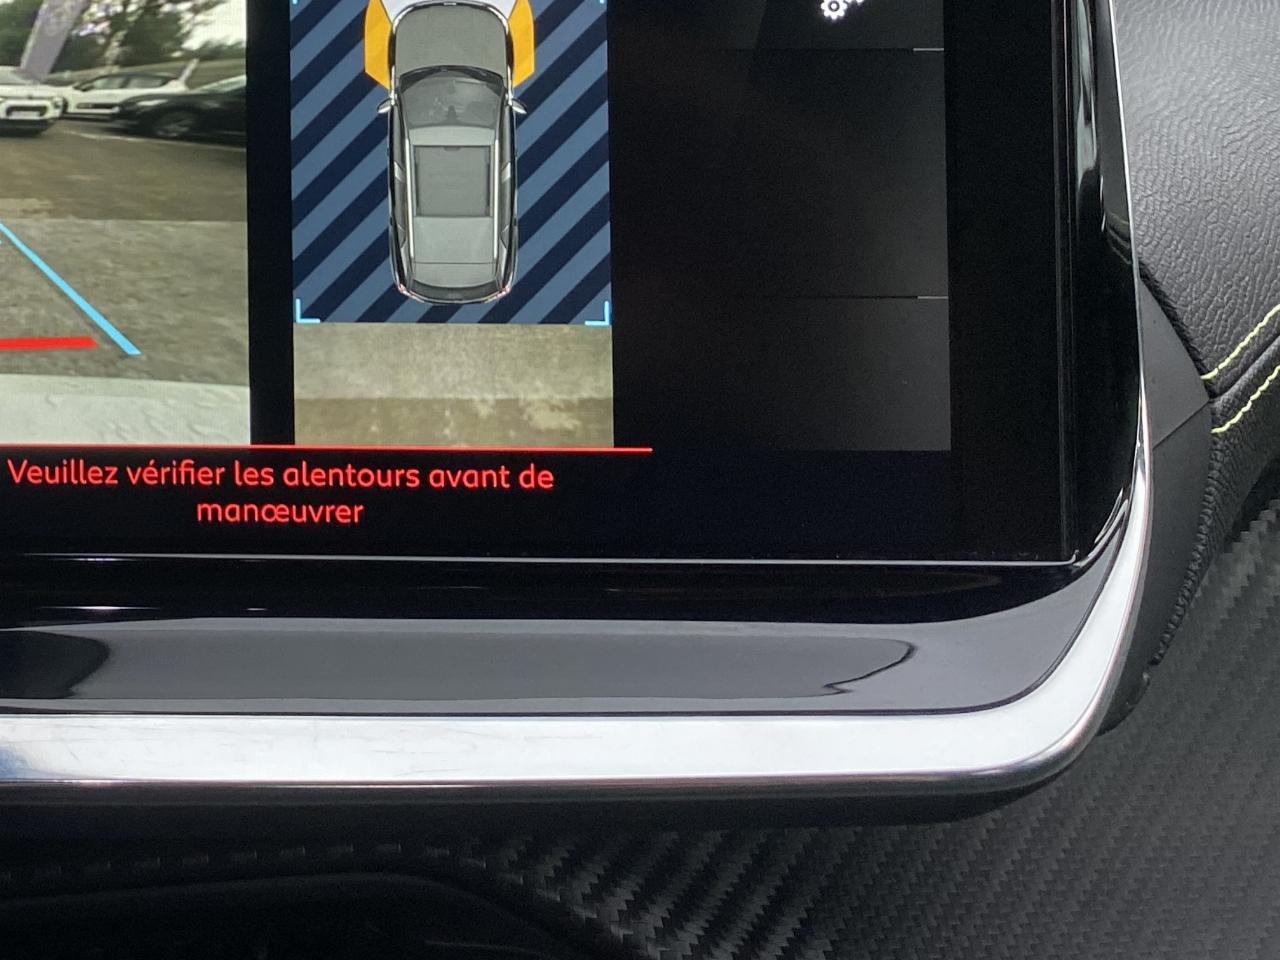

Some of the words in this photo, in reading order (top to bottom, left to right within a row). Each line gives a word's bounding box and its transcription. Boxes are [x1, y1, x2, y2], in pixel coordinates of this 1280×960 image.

[7, 458, 118, 486] Veuillez
[126, 460, 226, 487] vérifier
[234, 460, 274, 487] les
[283, 460, 420, 489] alentours
[428, 463, 511, 489] avant
[519, 462, 554, 489] de
[196, 500, 364, 525] manœuvrer
